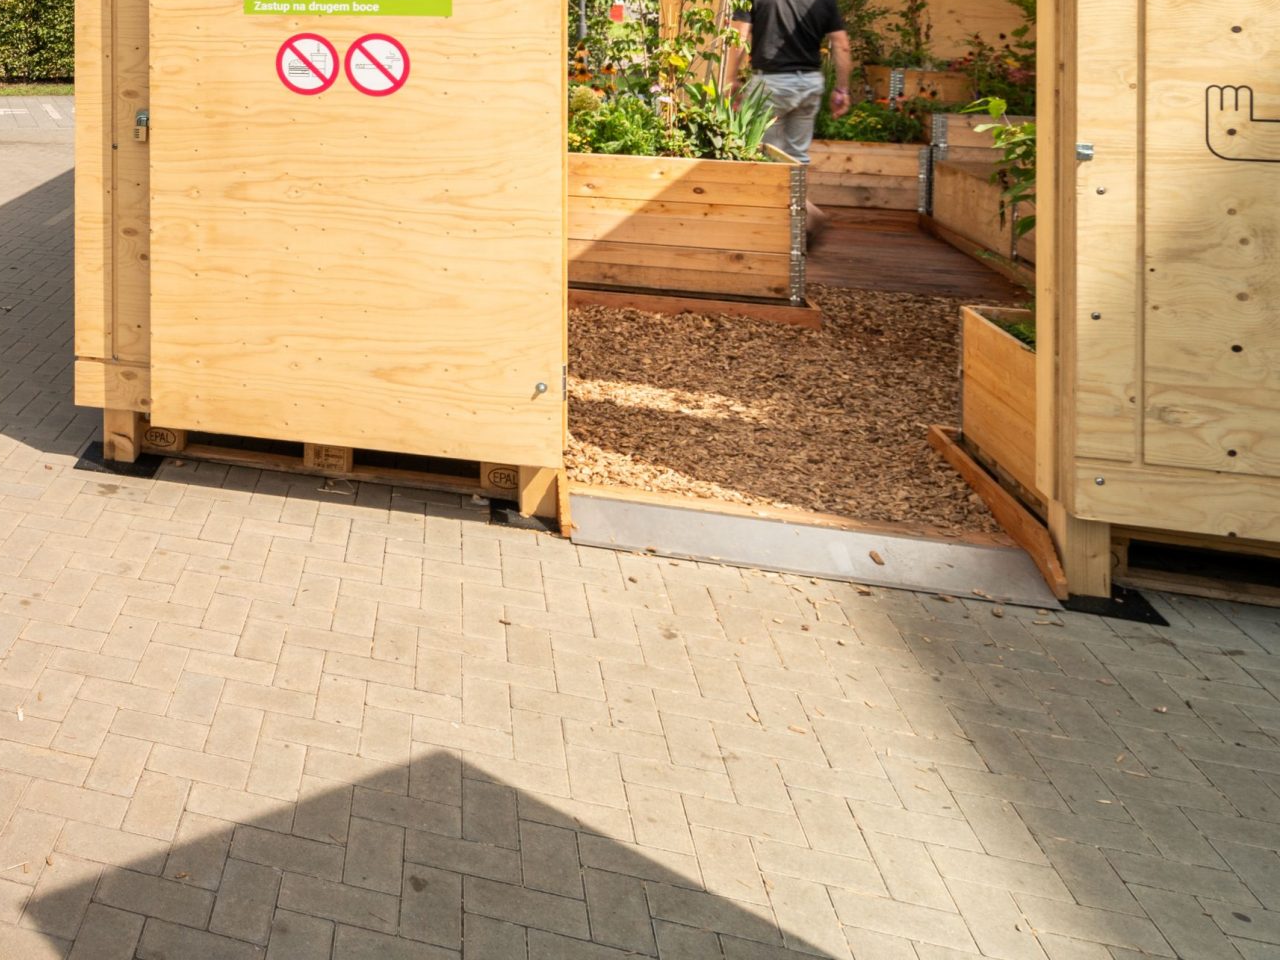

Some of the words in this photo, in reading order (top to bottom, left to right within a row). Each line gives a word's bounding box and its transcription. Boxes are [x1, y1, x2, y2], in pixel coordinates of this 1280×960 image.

[253, 1, 290, 13] Zastup
[293, 3, 306, 11] na
[309, 1, 350, 13] drugem
[352, 2, 379, 12] boce
